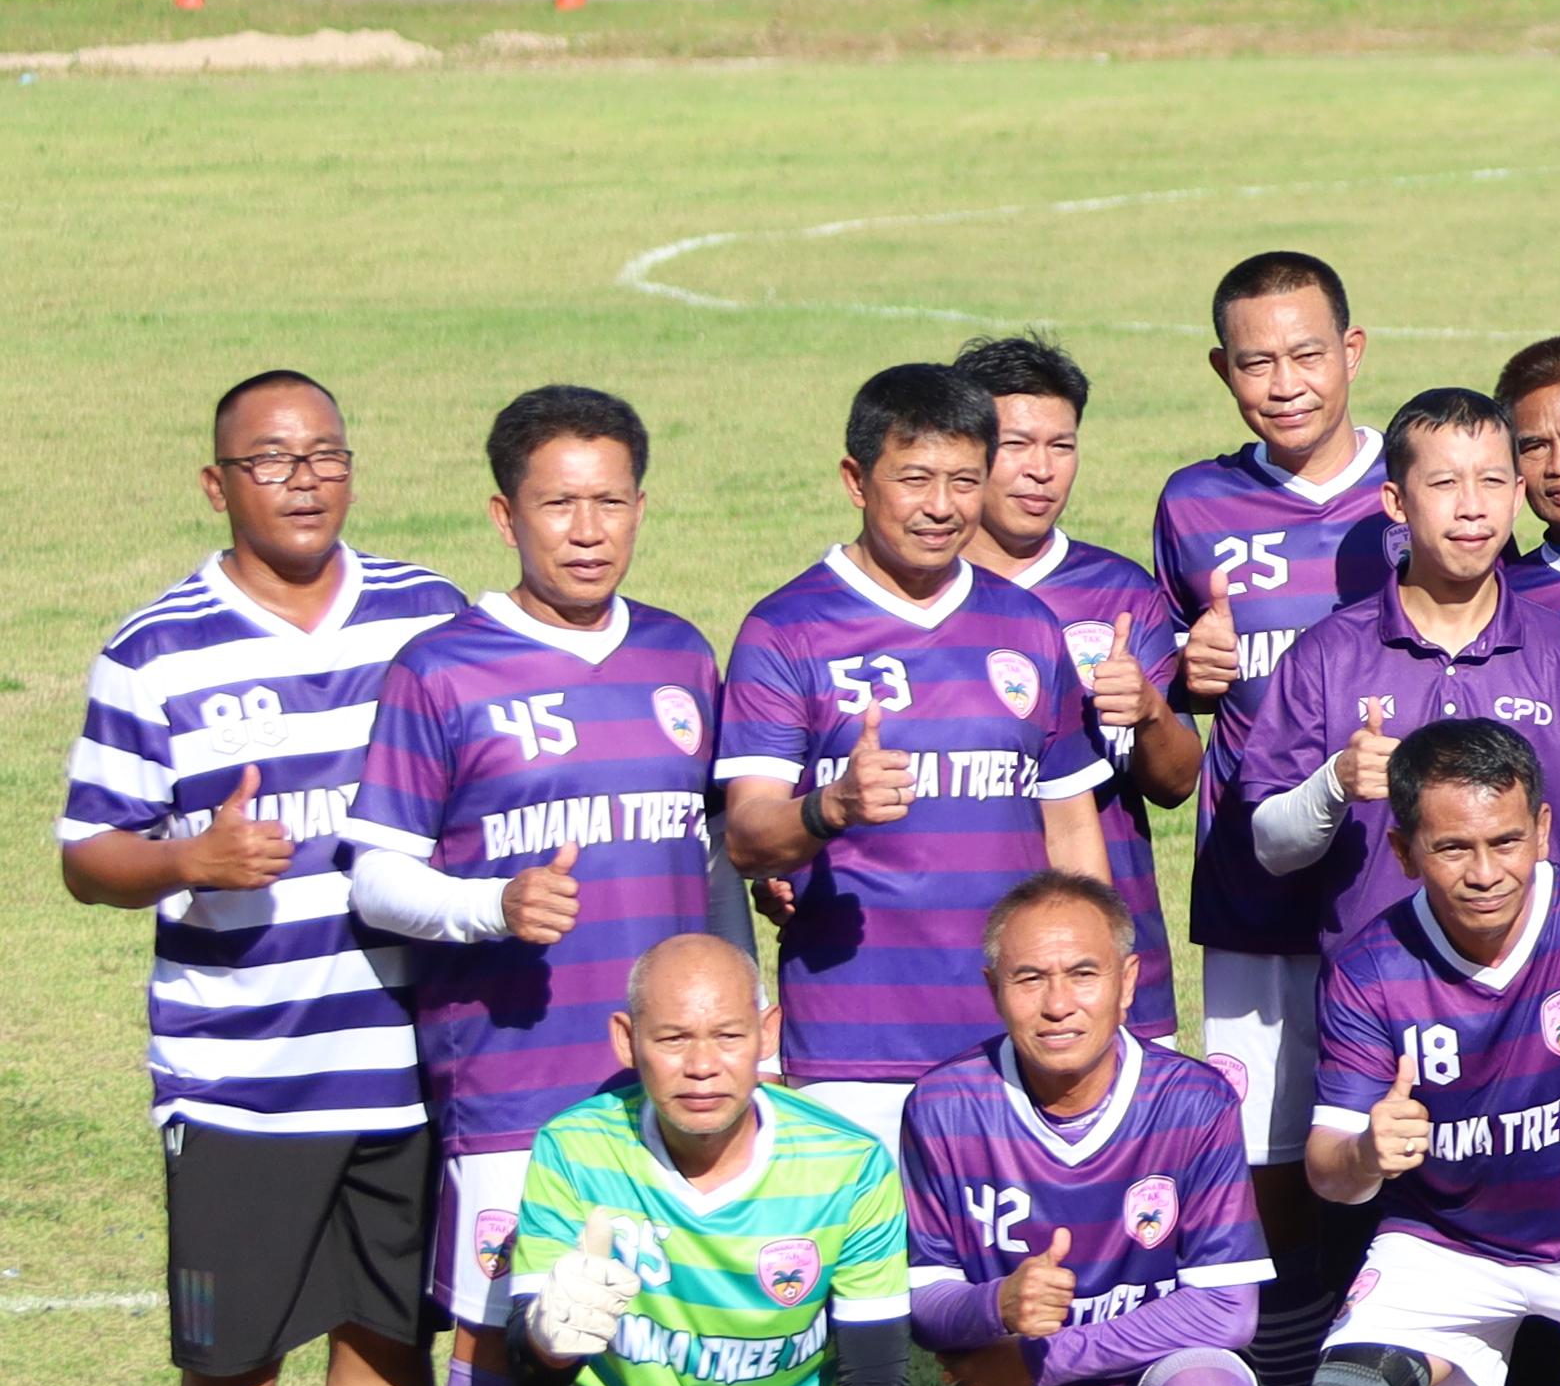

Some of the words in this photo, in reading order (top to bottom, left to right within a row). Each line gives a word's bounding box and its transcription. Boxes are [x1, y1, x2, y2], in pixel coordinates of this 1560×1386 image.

[1213, 531, 1289, 596] 25
[828, 654, 912, 715] 53
[1494, 696, 1553, 726] CPD
[201, 685, 288, 755] 88
[489, 693, 578, 761] 45
[949, 751, 1021, 802] TREE
[482, 794, 613, 862] BANANA
[618, 792, 693, 844] TREE
[1403, 1023, 1461, 1086] 18
[964, 1183, 1033, 1254] 42
[695, 1334, 783, 1386] TREE
